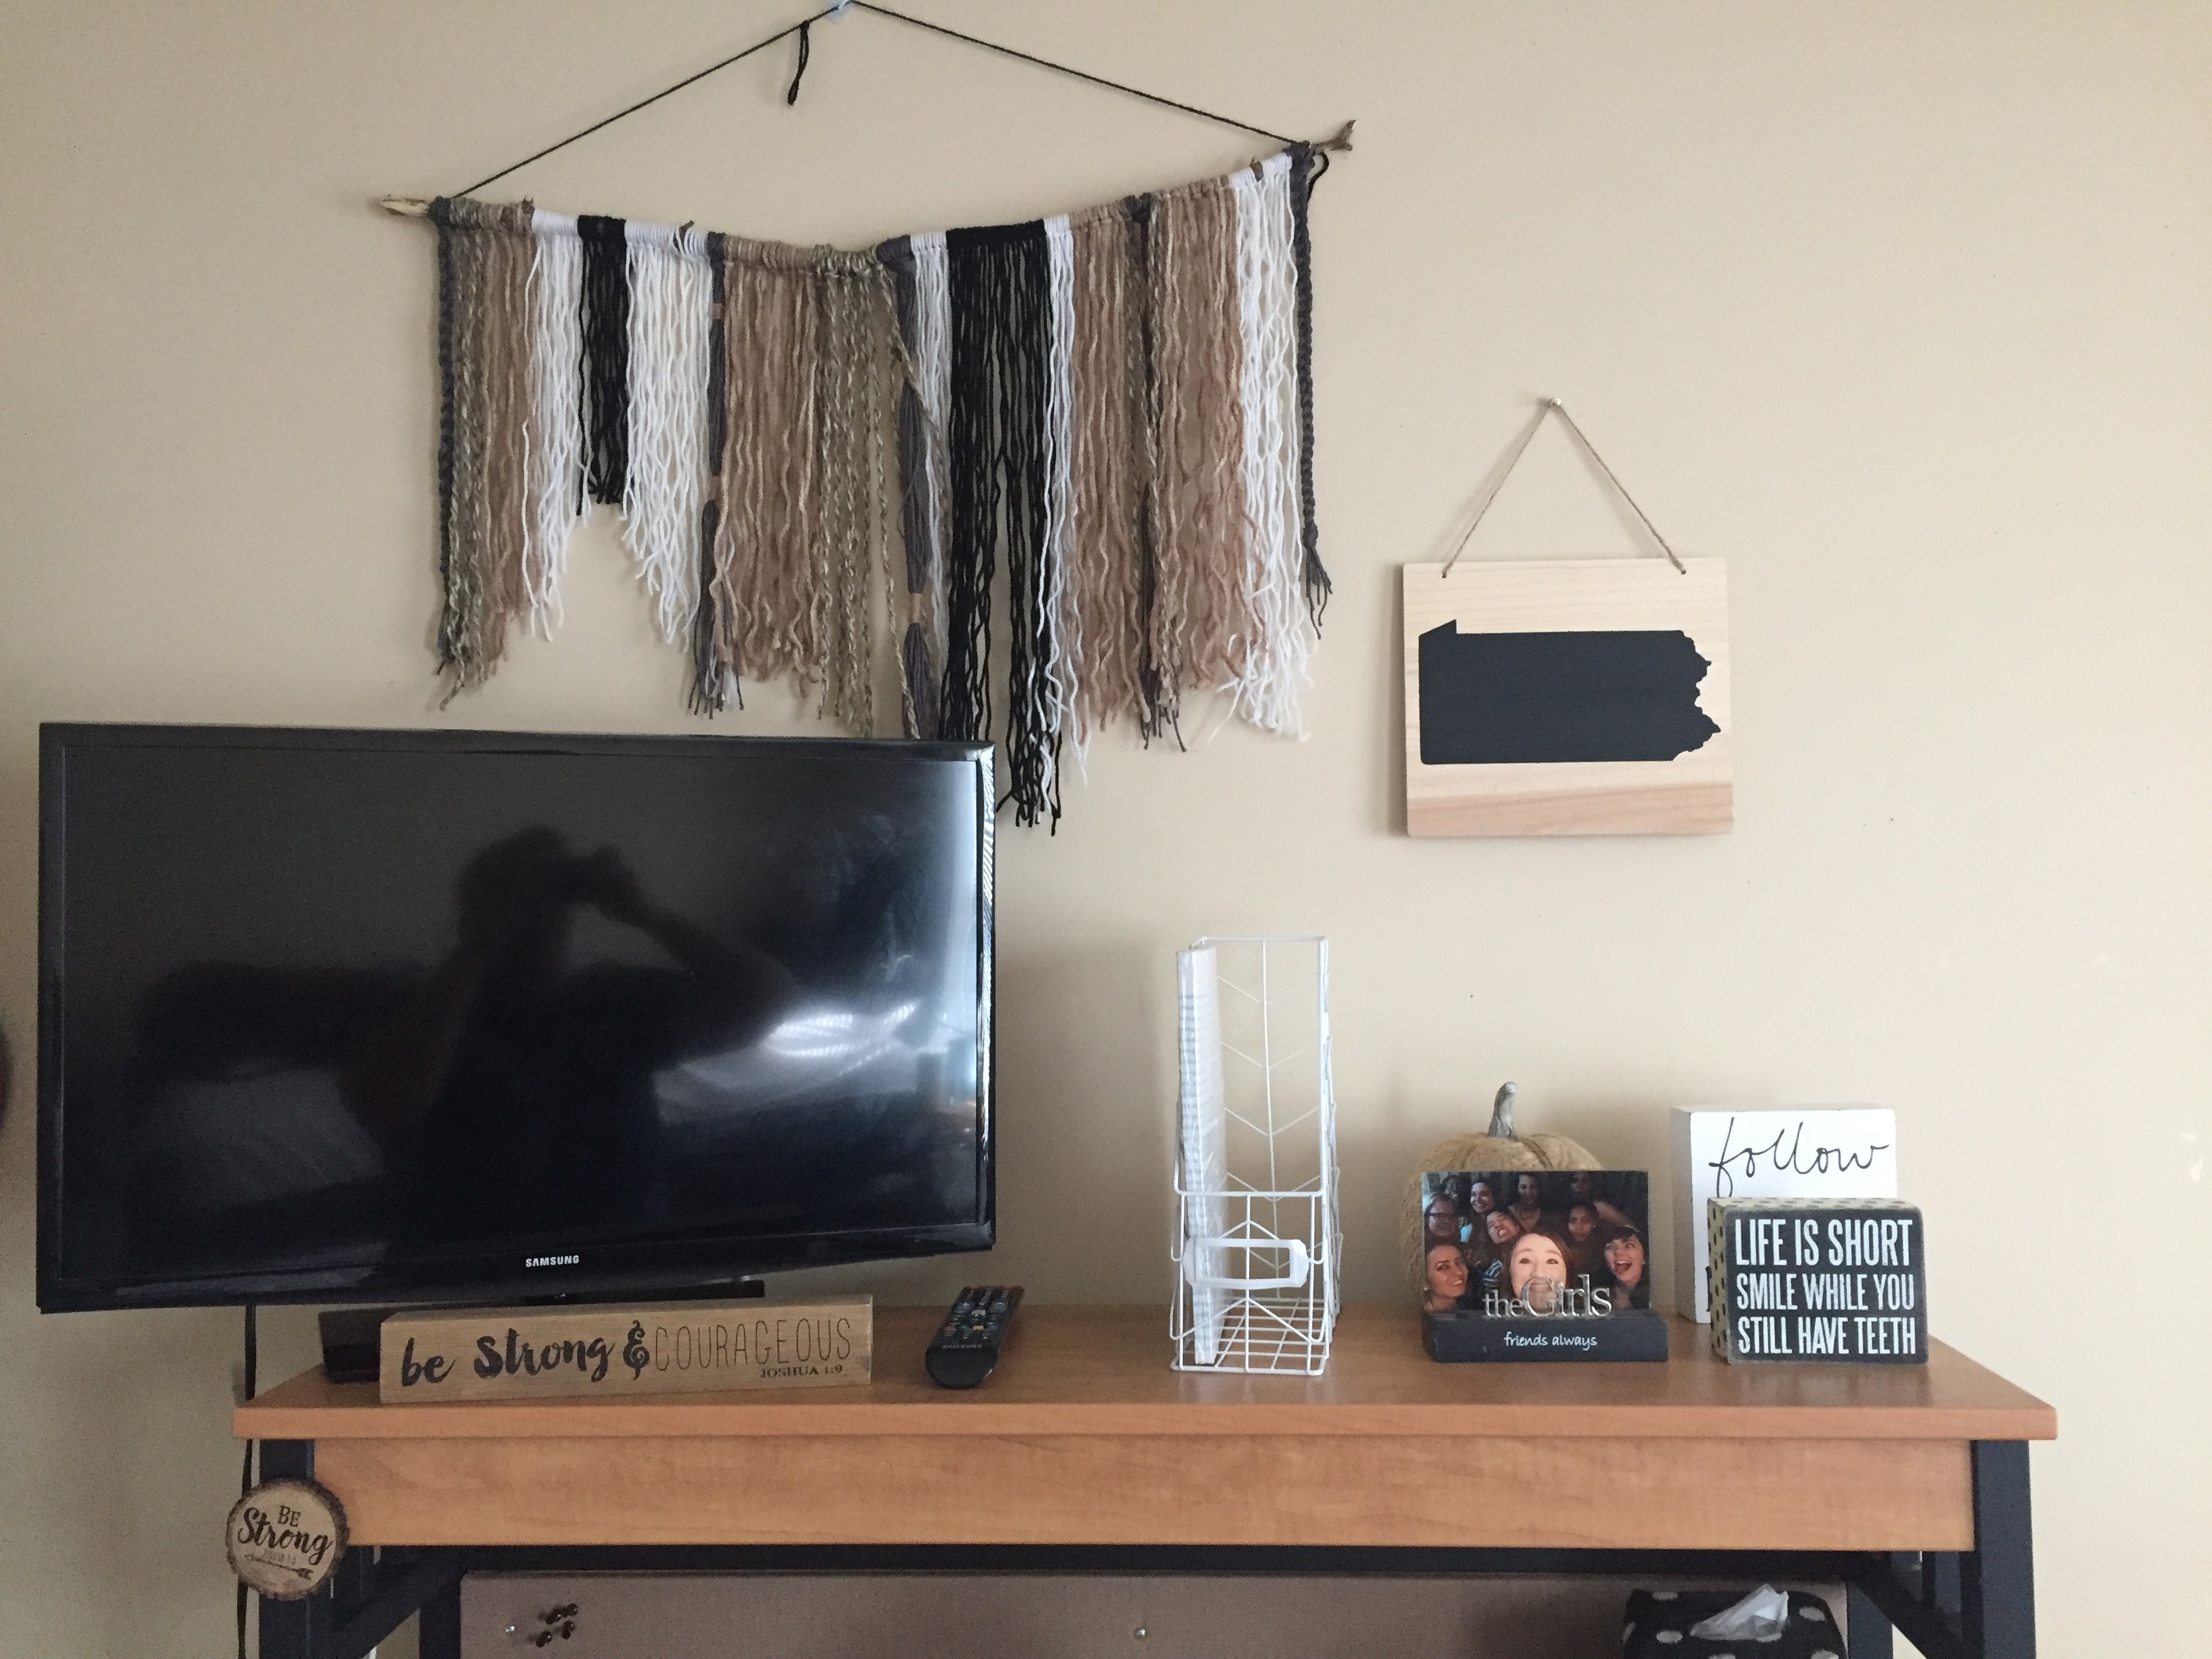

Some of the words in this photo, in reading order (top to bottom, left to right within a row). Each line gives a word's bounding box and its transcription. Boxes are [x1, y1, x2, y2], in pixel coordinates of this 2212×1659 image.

[1708, 1117, 1889, 1197] follow
[525, 1254, 579, 1267] SAMSUNG
[1735, 1218, 1787, 1266] LIFE
[1795, 1219, 1819, 1266] IS
[1828, 1219, 1912, 1266] SHORT
[1736, 1273, 1798, 1310] SMILE
[1802, 1273, 1868, 1310] WHILE
[1873, 1274, 1914, 1310] YOU
[401, 1337, 454, 1387] be
[622, 1320, 650, 1380] &
[655, 1318, 851, 1372] COURAGEOUS
[1504, 1331, 1549, 1347] friends
[1552, 1334, 1597, 1351] always
[1738, 1316, 1791, 1353] STILL
[1798, 1317, 1849, 1354] HAVE
[1855, 1317, 1915, 1354] TEETH
[760, 1366, 819, 1378] JOSHUA
[824, 1364, 843, 1374] 1:9
[277, 1505, 301, 1528] BE
[238, 1507, 333, 1565] Strong
